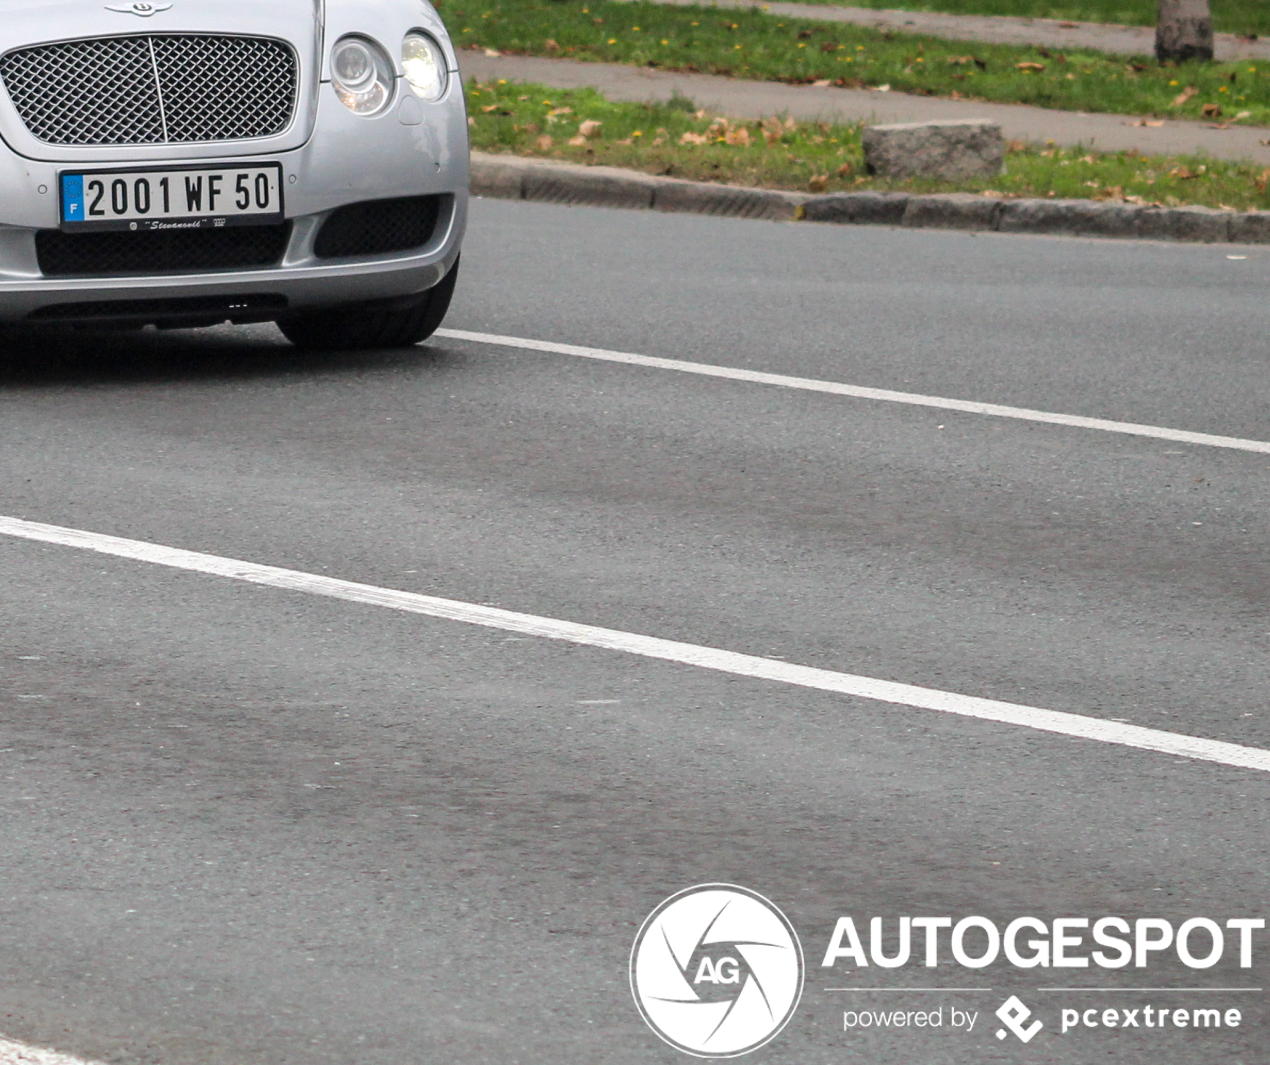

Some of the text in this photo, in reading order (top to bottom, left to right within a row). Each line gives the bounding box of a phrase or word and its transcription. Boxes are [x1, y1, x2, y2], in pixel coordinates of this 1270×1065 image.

[88, 173, 270, 215] 2001 WF 50
[70, 203, 78, 214] F
